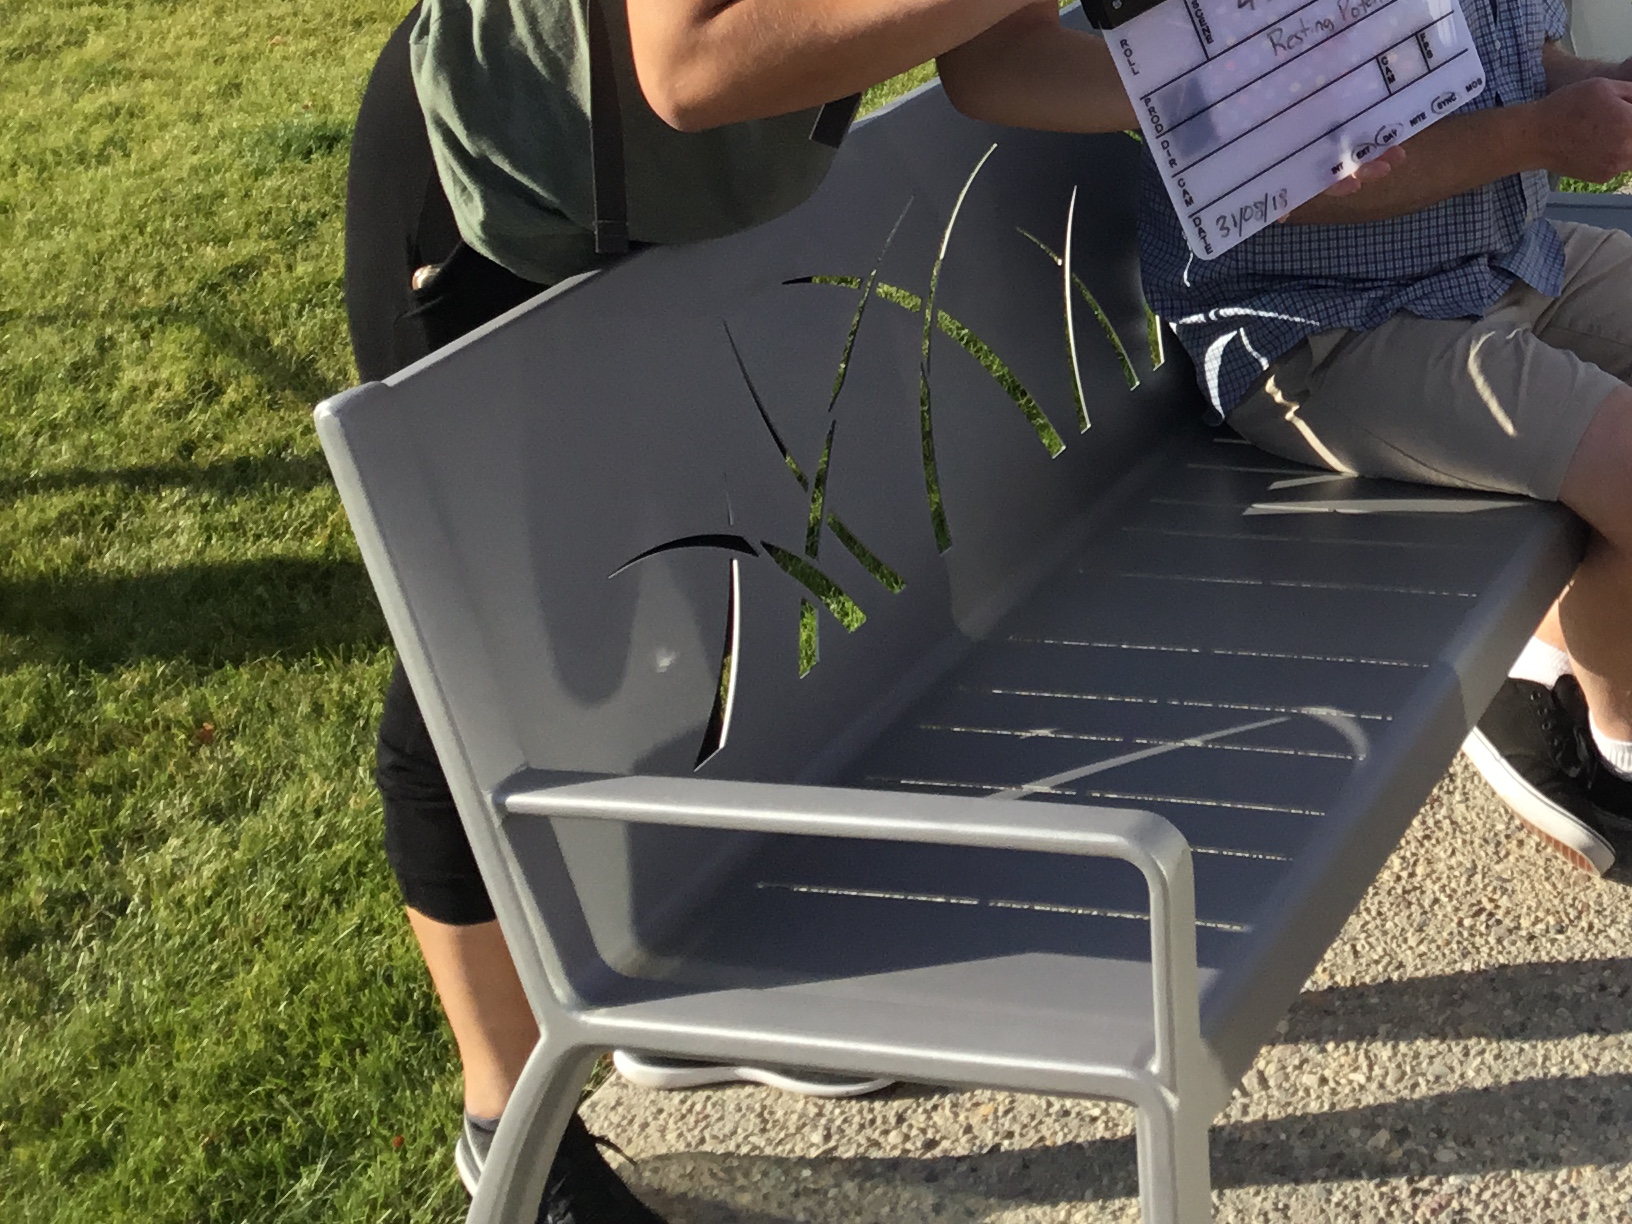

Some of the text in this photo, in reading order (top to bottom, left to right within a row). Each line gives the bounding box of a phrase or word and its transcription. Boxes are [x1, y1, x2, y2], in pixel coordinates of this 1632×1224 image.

[1191, 0, 1215, 45] SCENE
[1266, 18, 1335, 56] Resting
[1120, 38, 1140, 76] ROLL
[1380, 56, 1396, 84] CAM
[1144, 97, 1164, 134] PROD
[1331, 78, 1483, 175] INT EXT DAY NITE SYNC MOS
[1160, 139, 1178, 169] DIR
[1177, 177, 1195, 208] CAM
[1215, 187, 1288, 238] 31/08/18
[1192, 216, 1214, 256] DATE
